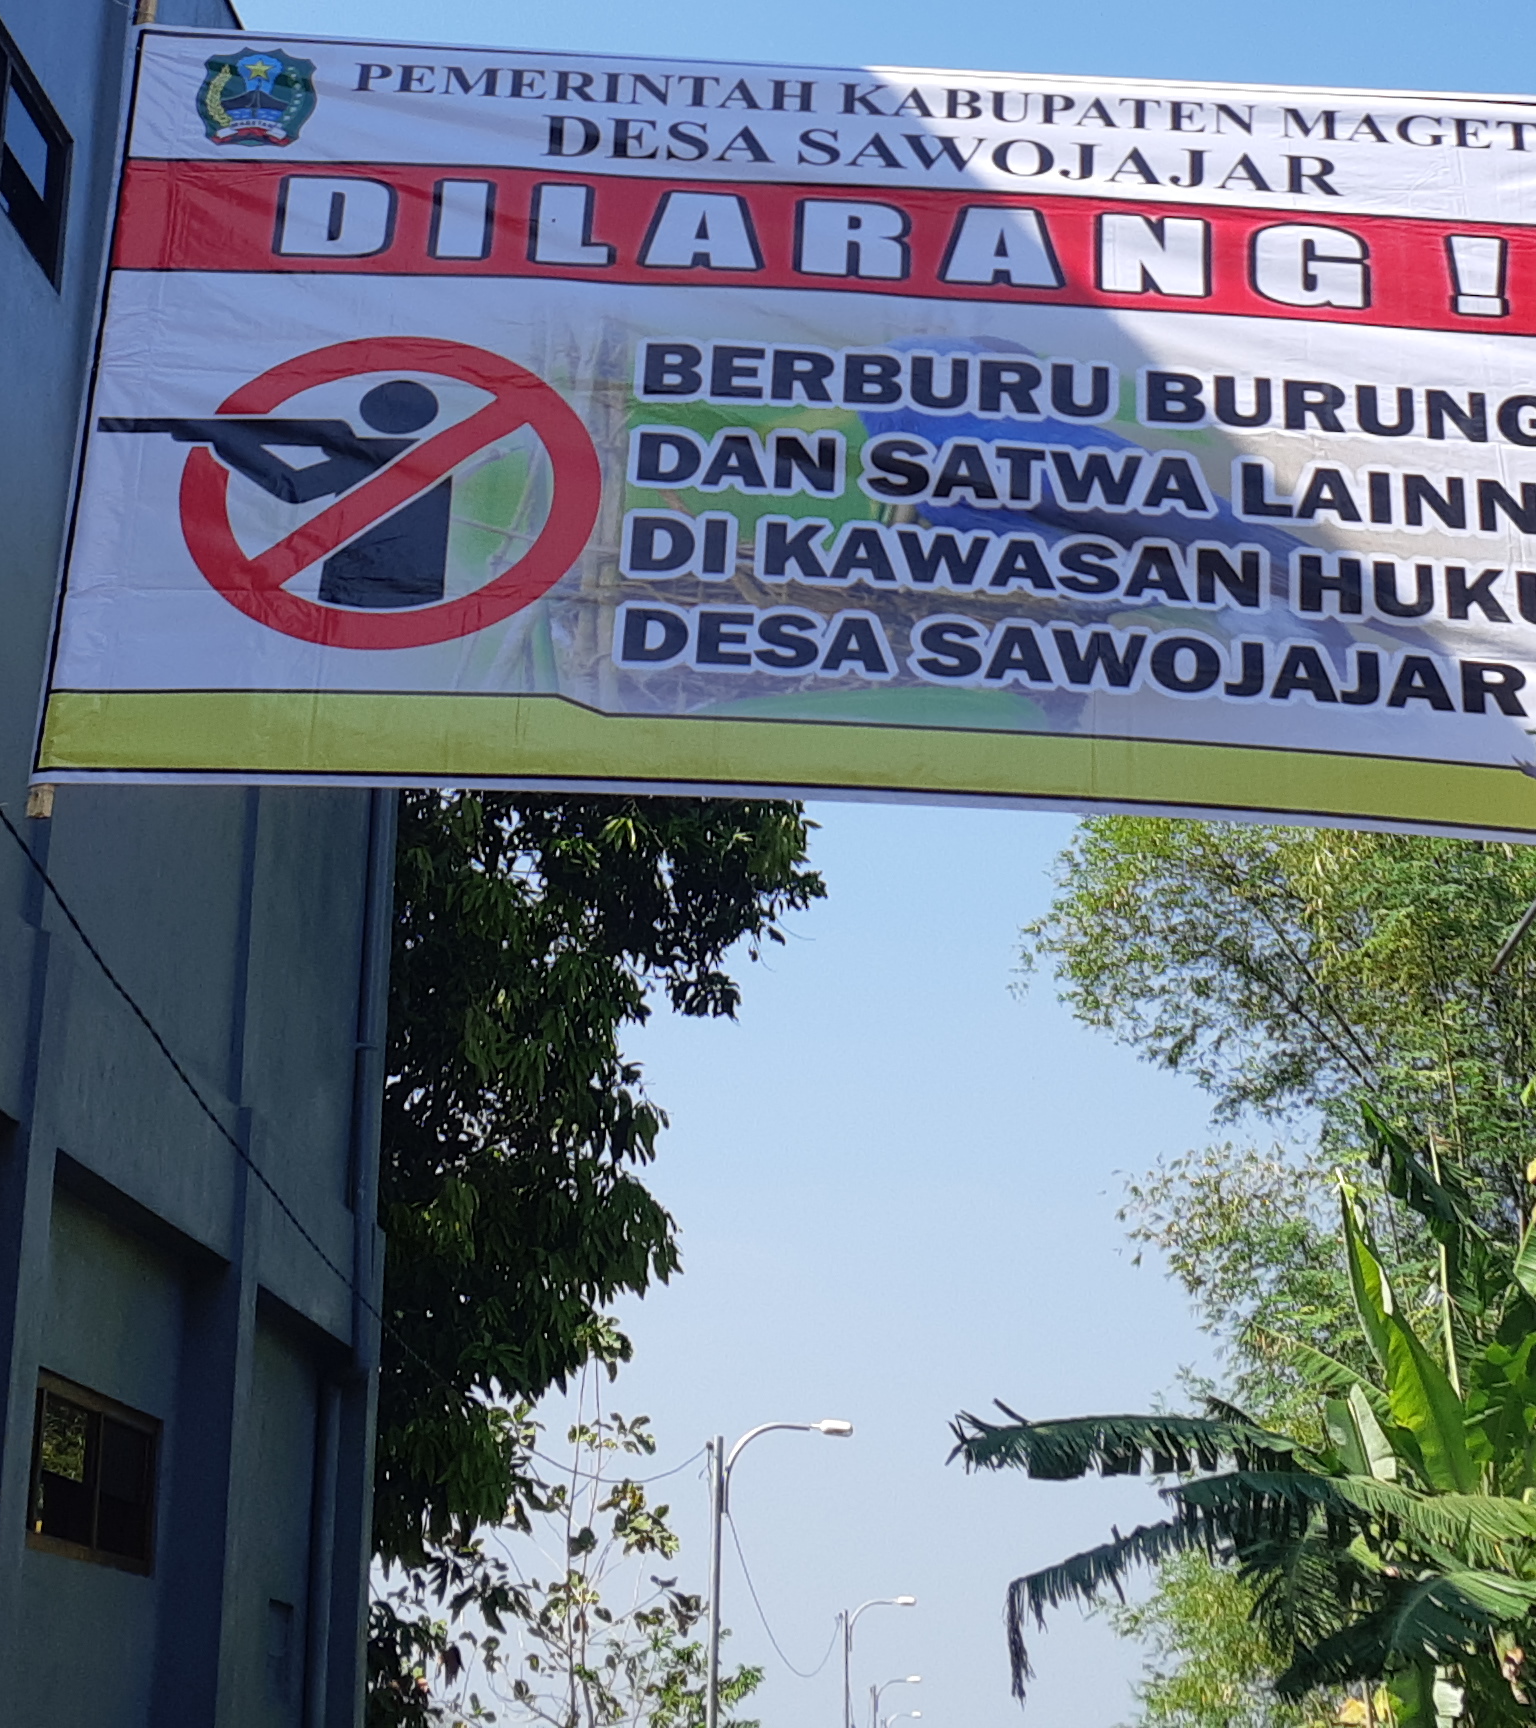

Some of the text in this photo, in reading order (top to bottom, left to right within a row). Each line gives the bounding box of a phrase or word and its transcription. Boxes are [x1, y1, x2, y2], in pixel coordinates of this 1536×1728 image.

[355, 62, 814, 114] PEMERINTAH
[840, 75, 1256, 136] KABUPATEN
[541, 114, 1344, 197] DESA SAWOJAJAR
[271, 174, 1371, 310] DILARANG
[642, 342, 1110, 419] BERBURU
[635, 433, 837, 493] DAN
[869, 440, 1209, 514] SATWA
[629, 518, 726, 574] DI
[763, 523, 1258, 609] KAWASAN
[621, 608, 1527, 718] DESA SAWOJAJAR
